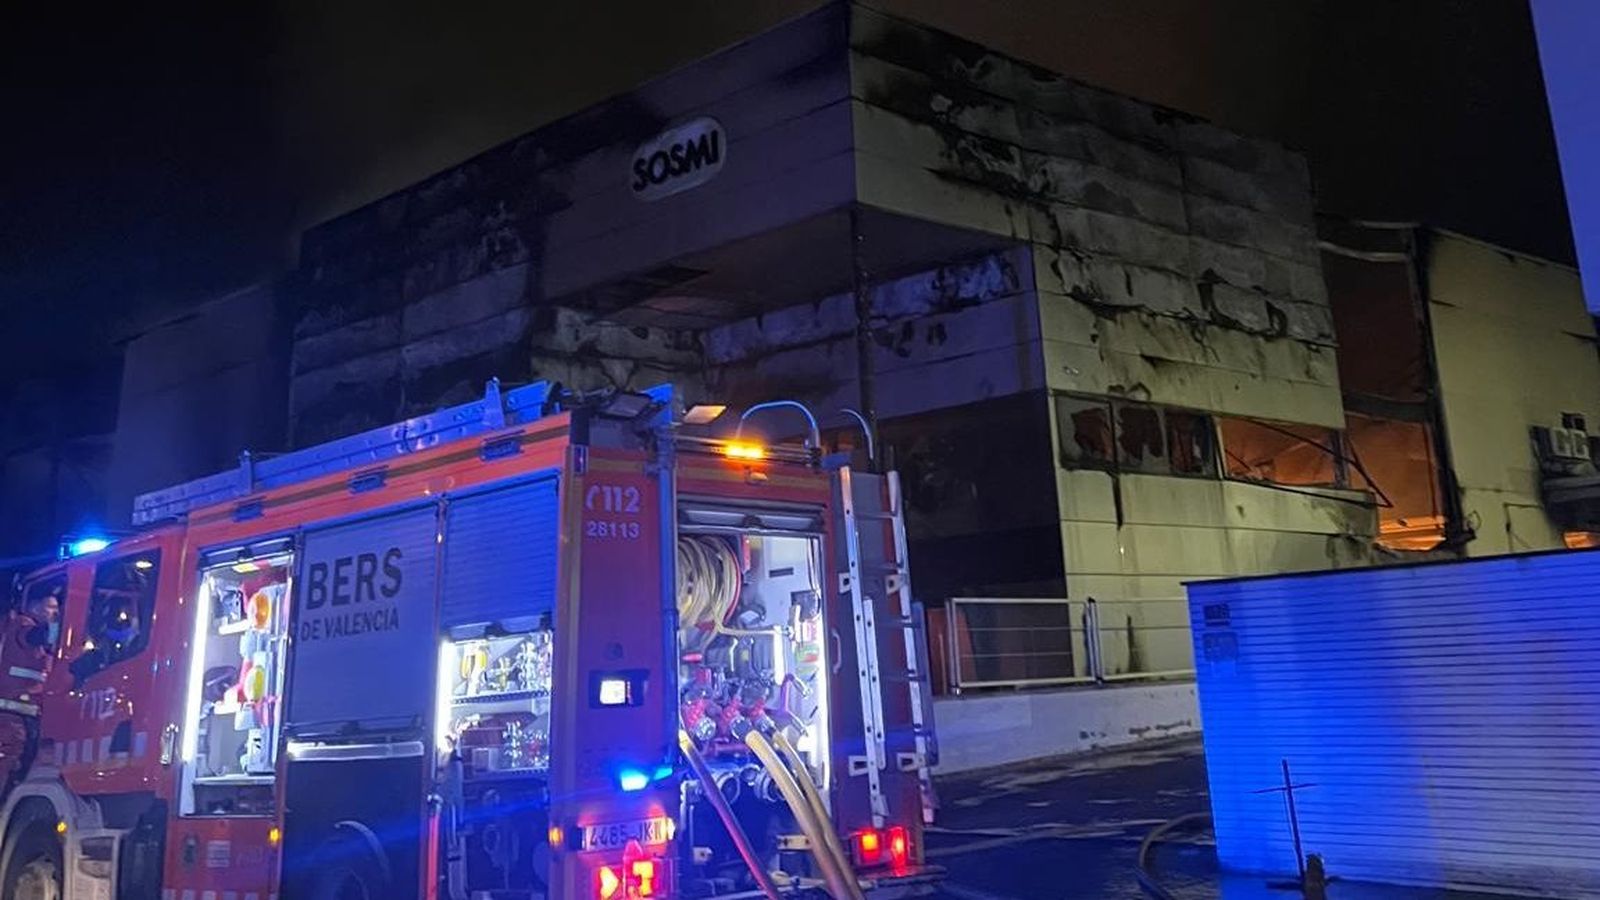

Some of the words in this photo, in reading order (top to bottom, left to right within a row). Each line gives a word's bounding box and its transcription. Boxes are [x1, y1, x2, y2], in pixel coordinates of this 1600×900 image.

[633, 129, 719, 192] SOSMI
[586, 521, 640, 538] 28113
[306, 547, 402, 610] BERS
[301, 620, 320, 642] DE
